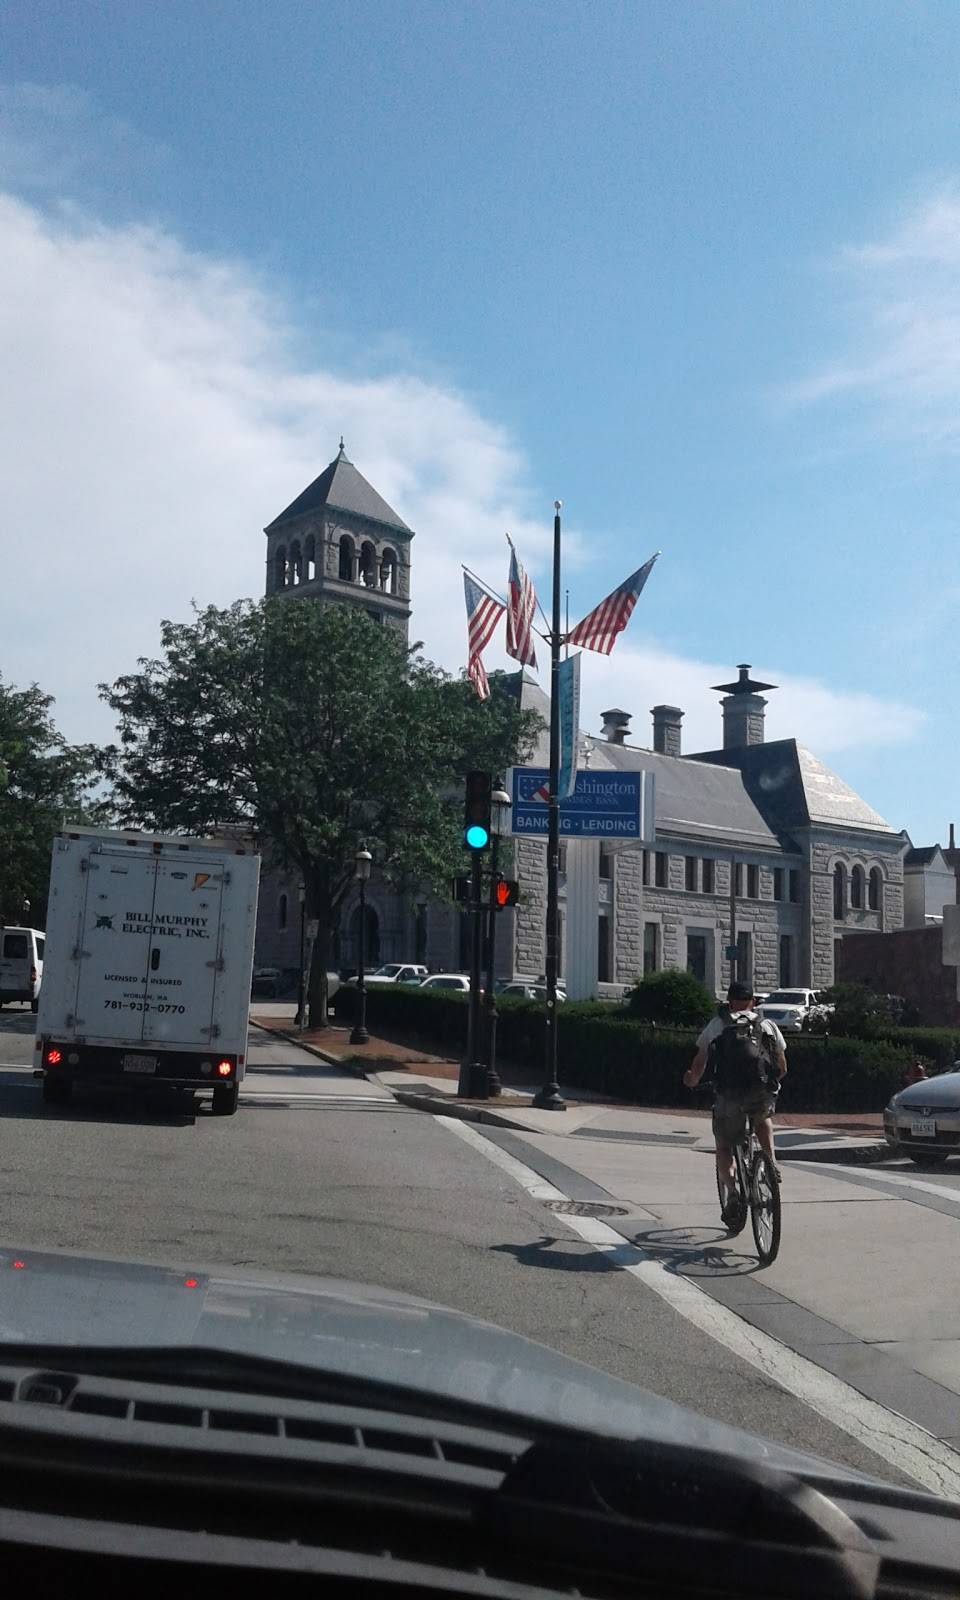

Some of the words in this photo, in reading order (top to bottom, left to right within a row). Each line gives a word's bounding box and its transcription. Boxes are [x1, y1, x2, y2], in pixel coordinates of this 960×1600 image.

[576, 779, 636, 796] shington
[516, 816, 571, 830] BANKG
[582, 819, 636, 831] LENDING
[126, 912, 152, 922] BILL
[155, 915, 208, 926] MURPHY
[122, 924, 182, 938] ELECTRIC,
[186, 928, 209, 939] INC.
[104, 974, 138, 983] LICENSED
[150, 978, 182, 986] INSURED
[104, 1000, 186, 1014] 781-932-0770
